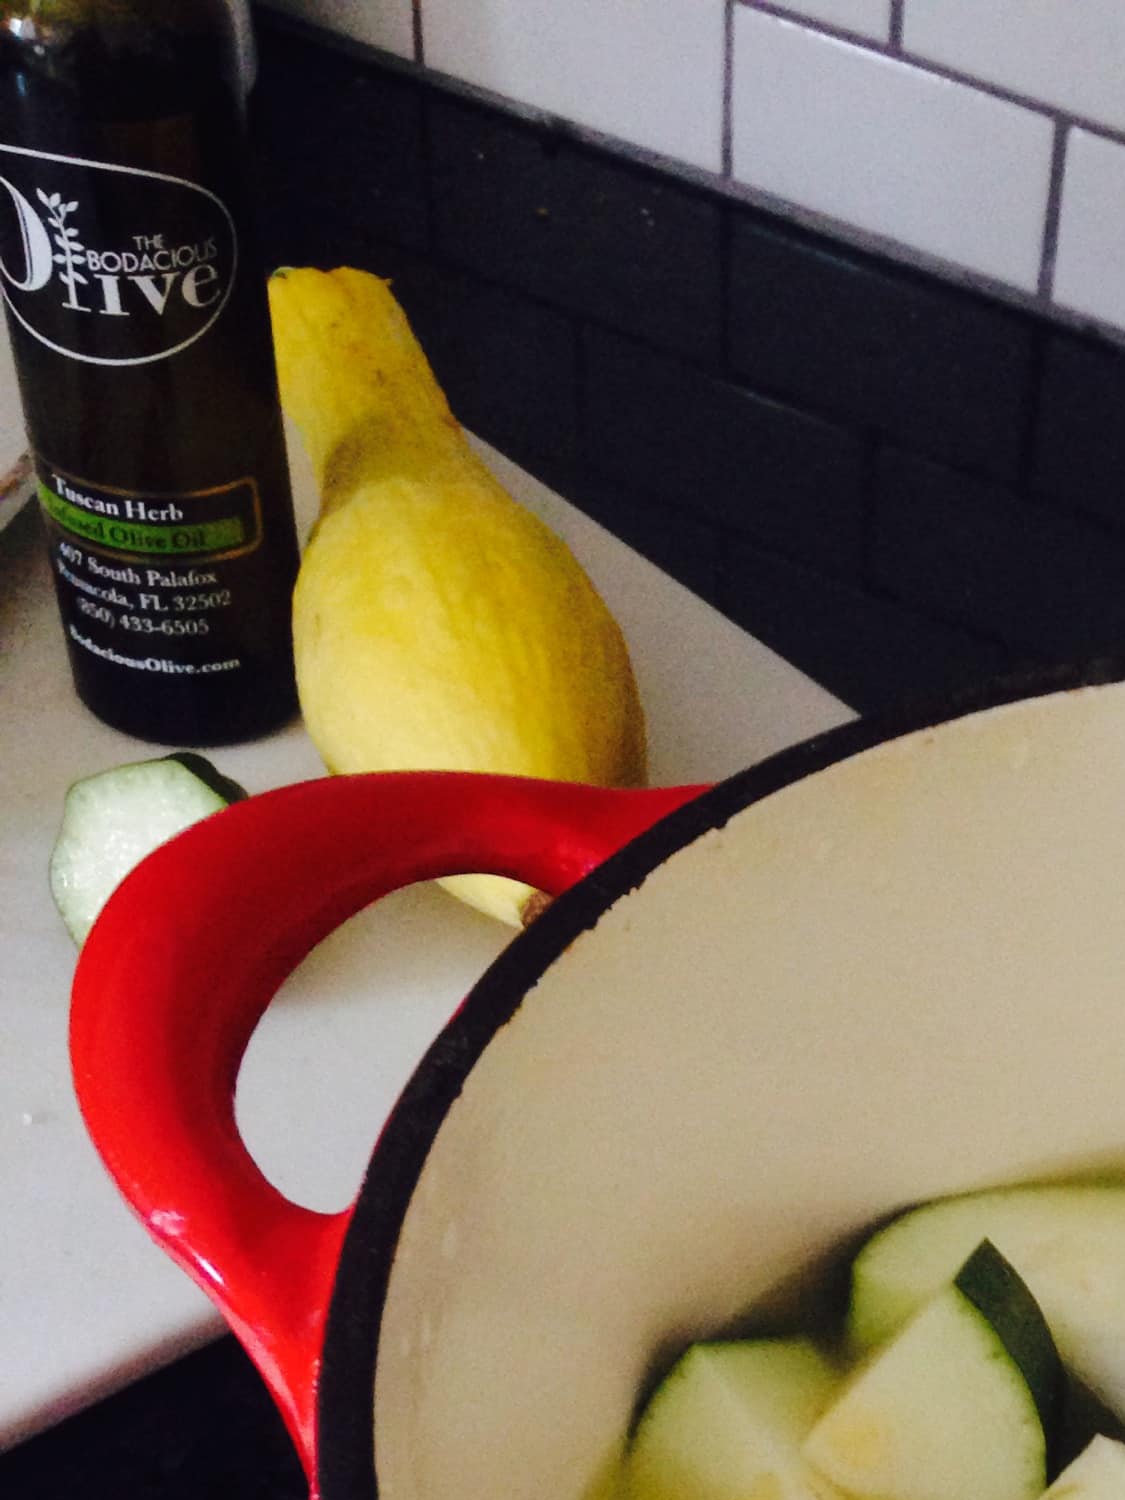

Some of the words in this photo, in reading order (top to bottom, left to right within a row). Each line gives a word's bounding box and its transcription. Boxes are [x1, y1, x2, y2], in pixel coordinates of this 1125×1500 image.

[132, 235, 164, 250] THE
[86, 240, 218, 272] BODACIOUS
[52, 474, 119, 516] Tuscan
[125, 500, 183, 522] Herb
[110, 526, 167, 546] Olive
[170, 526, 206, 547] Oil
[87, 556, 141, 585] South
[146, 569, 218, 587] Palafox
[139, 592, 169, 612] FL
[172, 590, 232, 612] 32502
[119, 615, 210, 636] 433-6505
